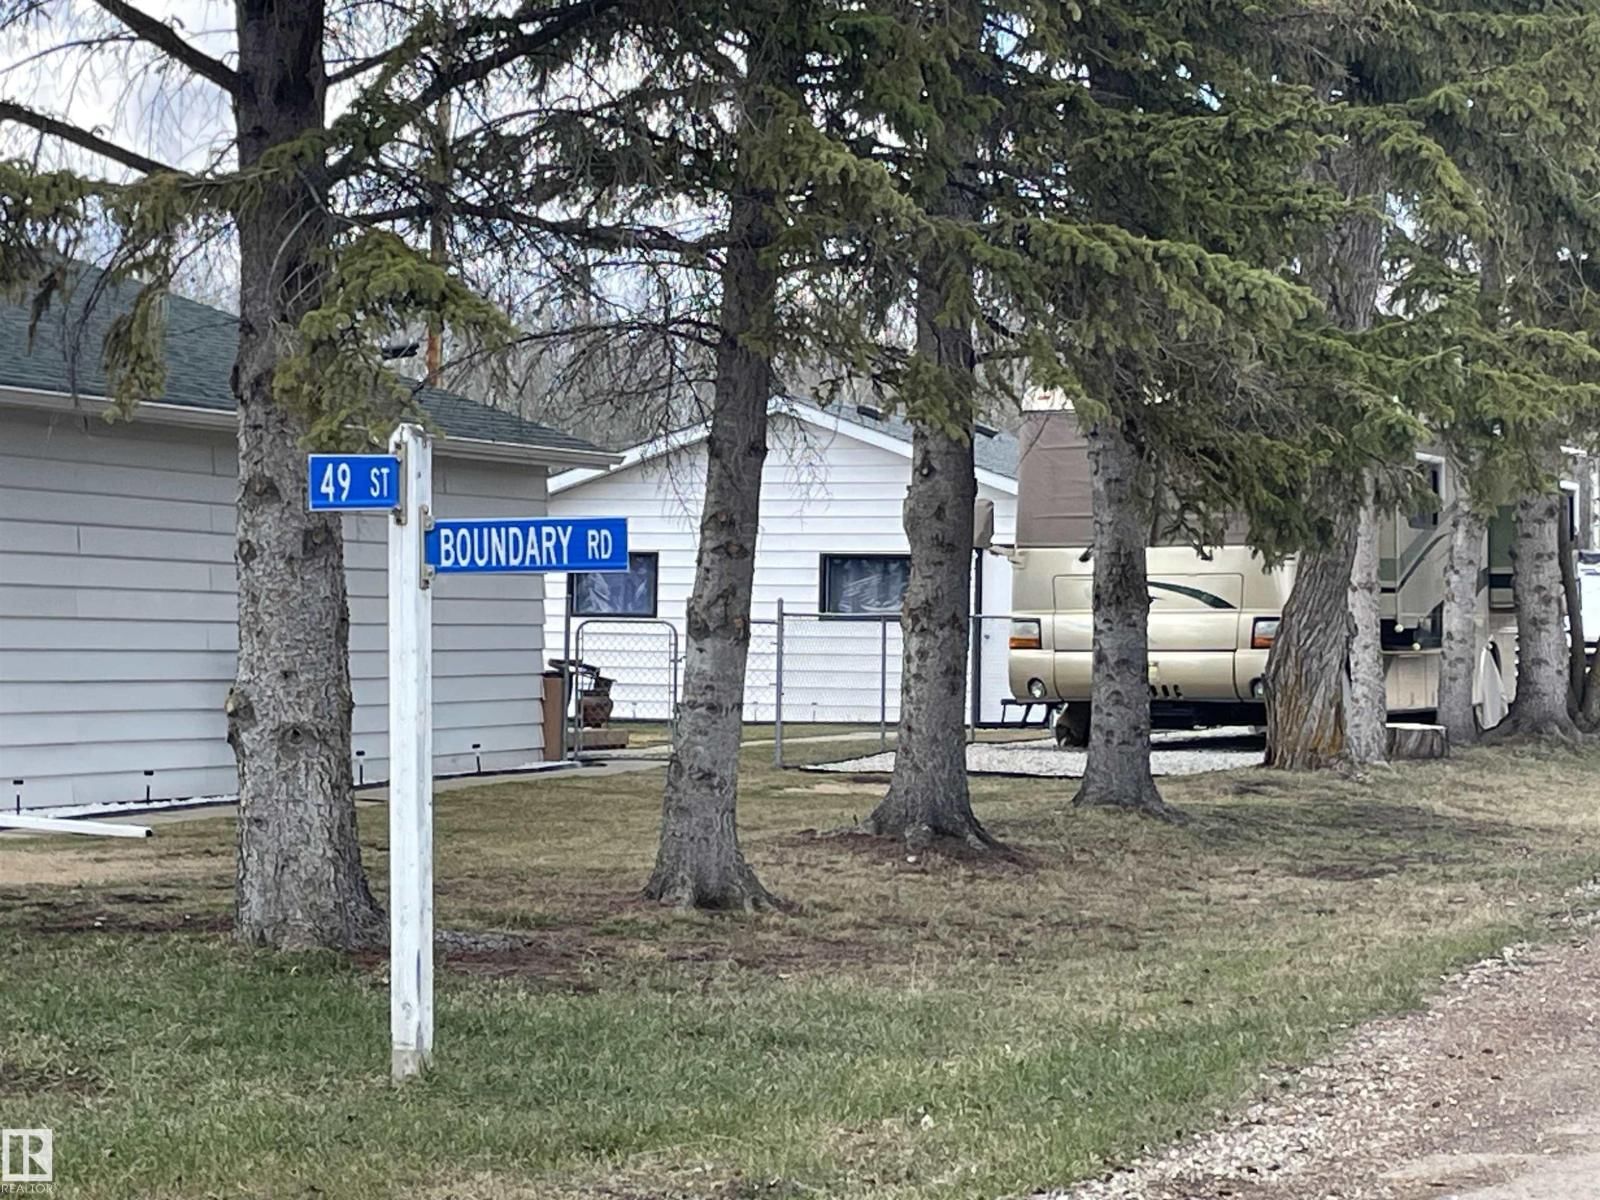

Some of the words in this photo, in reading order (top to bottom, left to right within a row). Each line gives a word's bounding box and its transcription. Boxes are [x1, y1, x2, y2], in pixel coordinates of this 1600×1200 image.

[320, 463, 351, 502] 49
[370, 467, 391, 498] ST
[439, 526, 573, 567] BOUNDARY
[587, 529, 613, 560] RD
